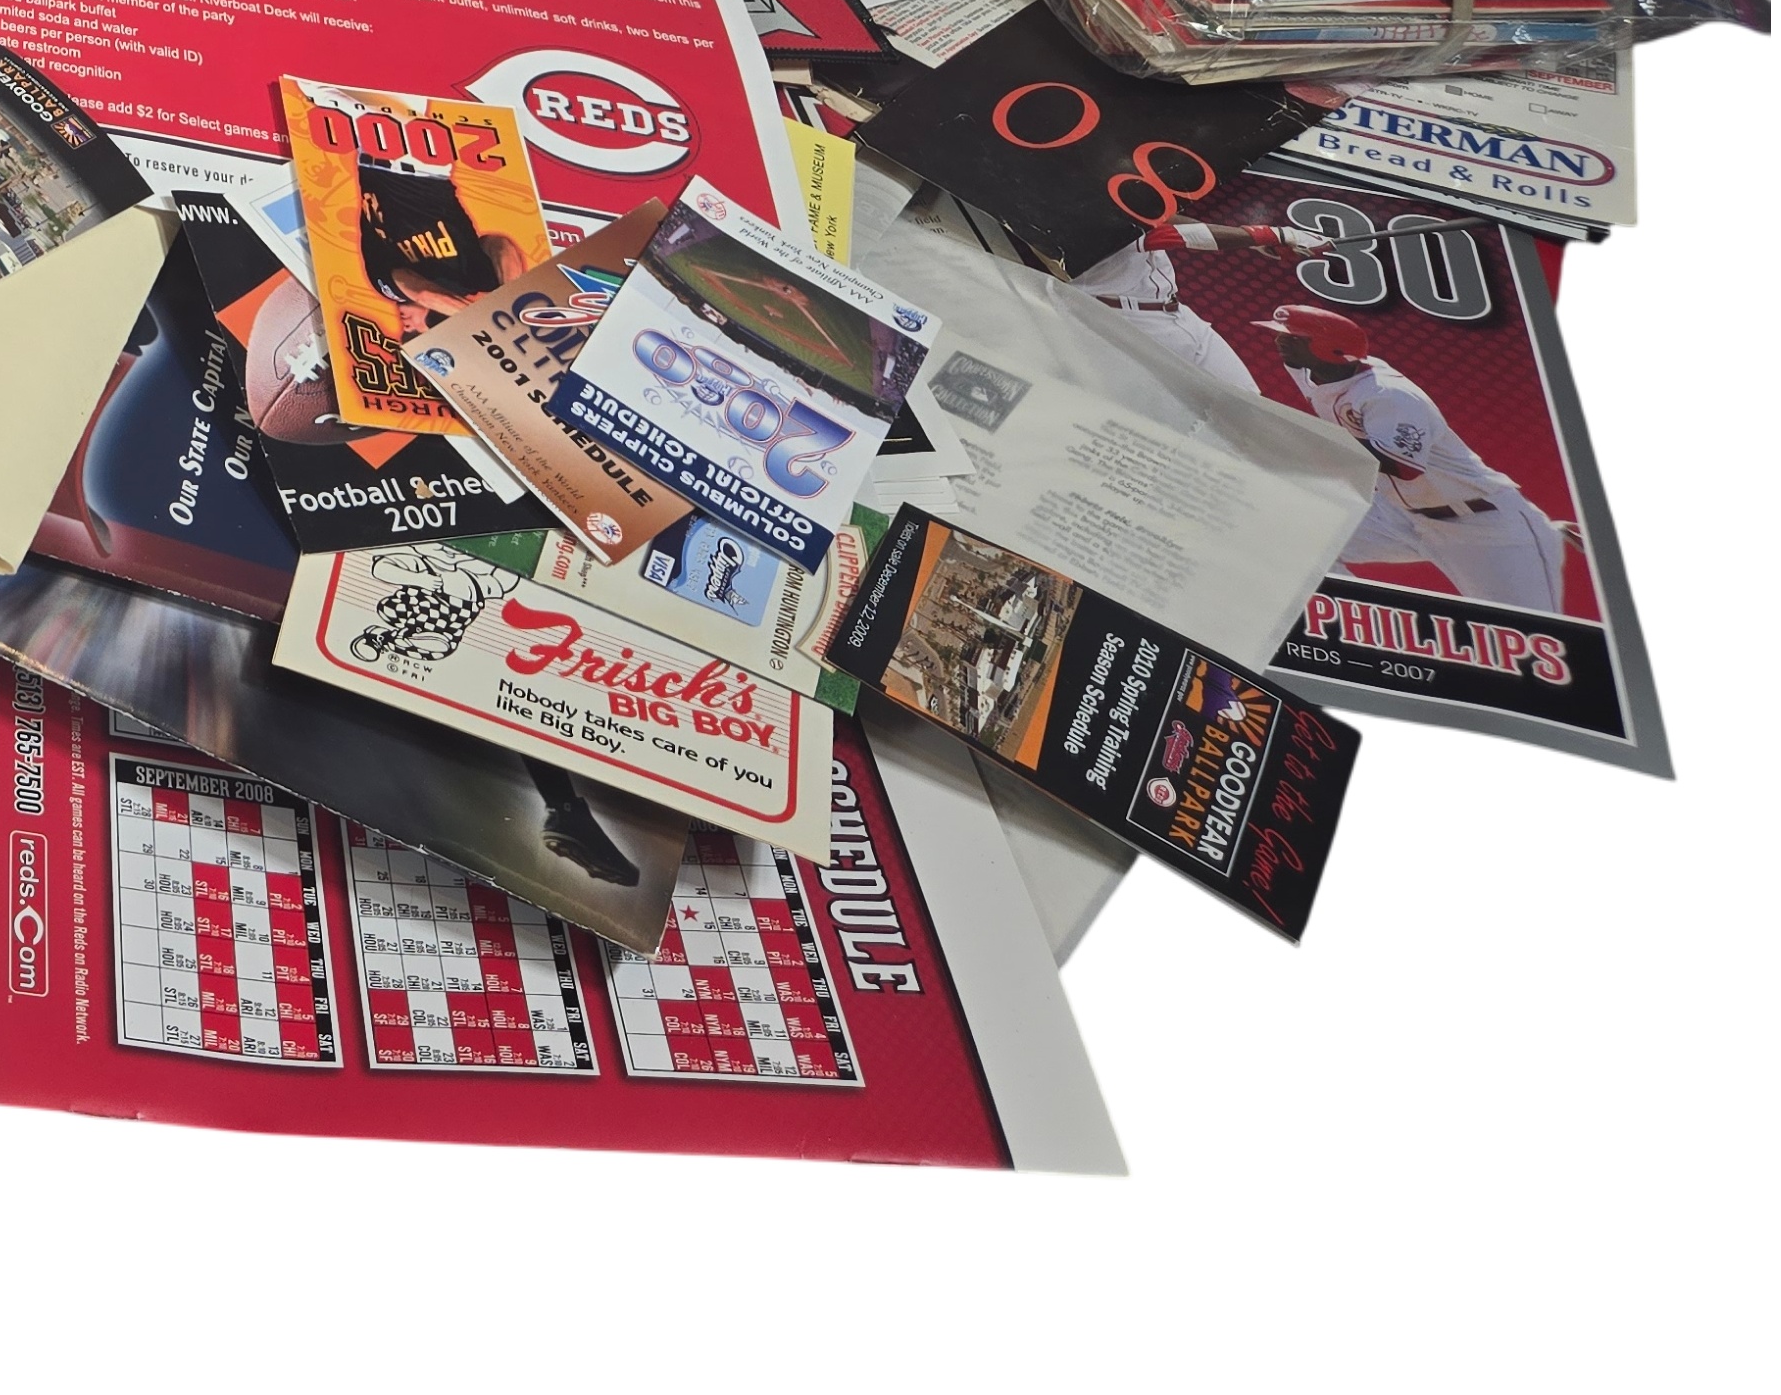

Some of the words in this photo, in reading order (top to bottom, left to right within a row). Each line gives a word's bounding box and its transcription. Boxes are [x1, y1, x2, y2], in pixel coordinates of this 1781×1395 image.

[0, 18, 37, 36] beers
[41, 28, 62, 44] per
[65, 31, 111, 51] person
[115, 37, 146, 54] (with
[149, 44, 180, 60] valid
[183, 50, 203, 65] ID)
[1528, 68, 1613, 92] SEPTEMBER
[107, 99, 133, 114] add
[137, 103, 153, 119] $2
[157, 107, 175, 122] for
[179, 111, 221, 131] Select
[224, 121, 269, 142] games
[531, 88, 691, 143] REDS
[307, 104, 507, 174] 2000
[145, 156, 201, 181] reserve
[205, 172, 235, 189] your
[1318, 133, 1432, 173] Bread
[1449, 164, 1473, 183] &
[1492, 174, 1592, 208] Rolls
[1287, 198, 1492, 322] 30
[569, 400, 675, 475] CLIPPERS
[578, 382, 697, 466] SCHEDULE
[179, 418, 211, 475] STATE
[169, 484, 200, 526] OUR
[279, 476, 405, 515] Football
[678, 470, 806, 552] COLUMBUS
[704, 462, 814, 534] OFFICIAL
[384, 502, 459, 533] 2007
[648, 552, 670, 582] VISA
[500, 597, 761, 715] Frisch's
[1134, 638, 1160, 677] 2010
[1304, 593, 1572, 686] PHILLIPS
[1090, 633, 1125, 692] Season
[1286, 641, 1342, 665] REDS
[1380, 660, 1436, 683] 2007
[608, 691, 683, 723] BIG
[693, 712, 777, 751] BOY
[1063, 685, 1106, 755] Schedule
[1109, 672, 1147, 735] Spring
[496, 695, 535, 719] like
[540, 710, 576, 740] Big
[581, 726, 626, 756] Boy.
[498, 678, 580, 722] Nobody
[584, 709, 649, 739] takes
[652, 736, 701, 764] care
[704, 755, 729, 774] of
[733, 763, 773, 791] you
[71, 743, 82, 758] are
[71, 760, 85, 780] EST.
[1086, 722, 1130, 791] Training
[71, 782, 86, 795] All
[136, 765, 230, 799] SEPTEMBER
[236, 781, 274, 804] 2008
[1168, 724, 1230, 848] BALLPARK
[1197, 740, 1256, 862] GOODYEAR
[69, 797, 83, 828] games
[296, 816, 310, 835] SUN
[72, 829, 85, 847] can
[72, 849, 86, 860] be
[73, 862, 87, 891] heard
[303, 886, 317, 907] TUE
[73, 892, 85, 905] on
[73, 907, 87, 923] the
[73, 925, 88, 950] Reds
[74, 952, 86, 965] on
[74, 967, 89, 996] Radio
[311, 958, 325, 979] THU
[75, 998, 91, 1045] Network.
[318, 1033, 333, 1054] SAT
